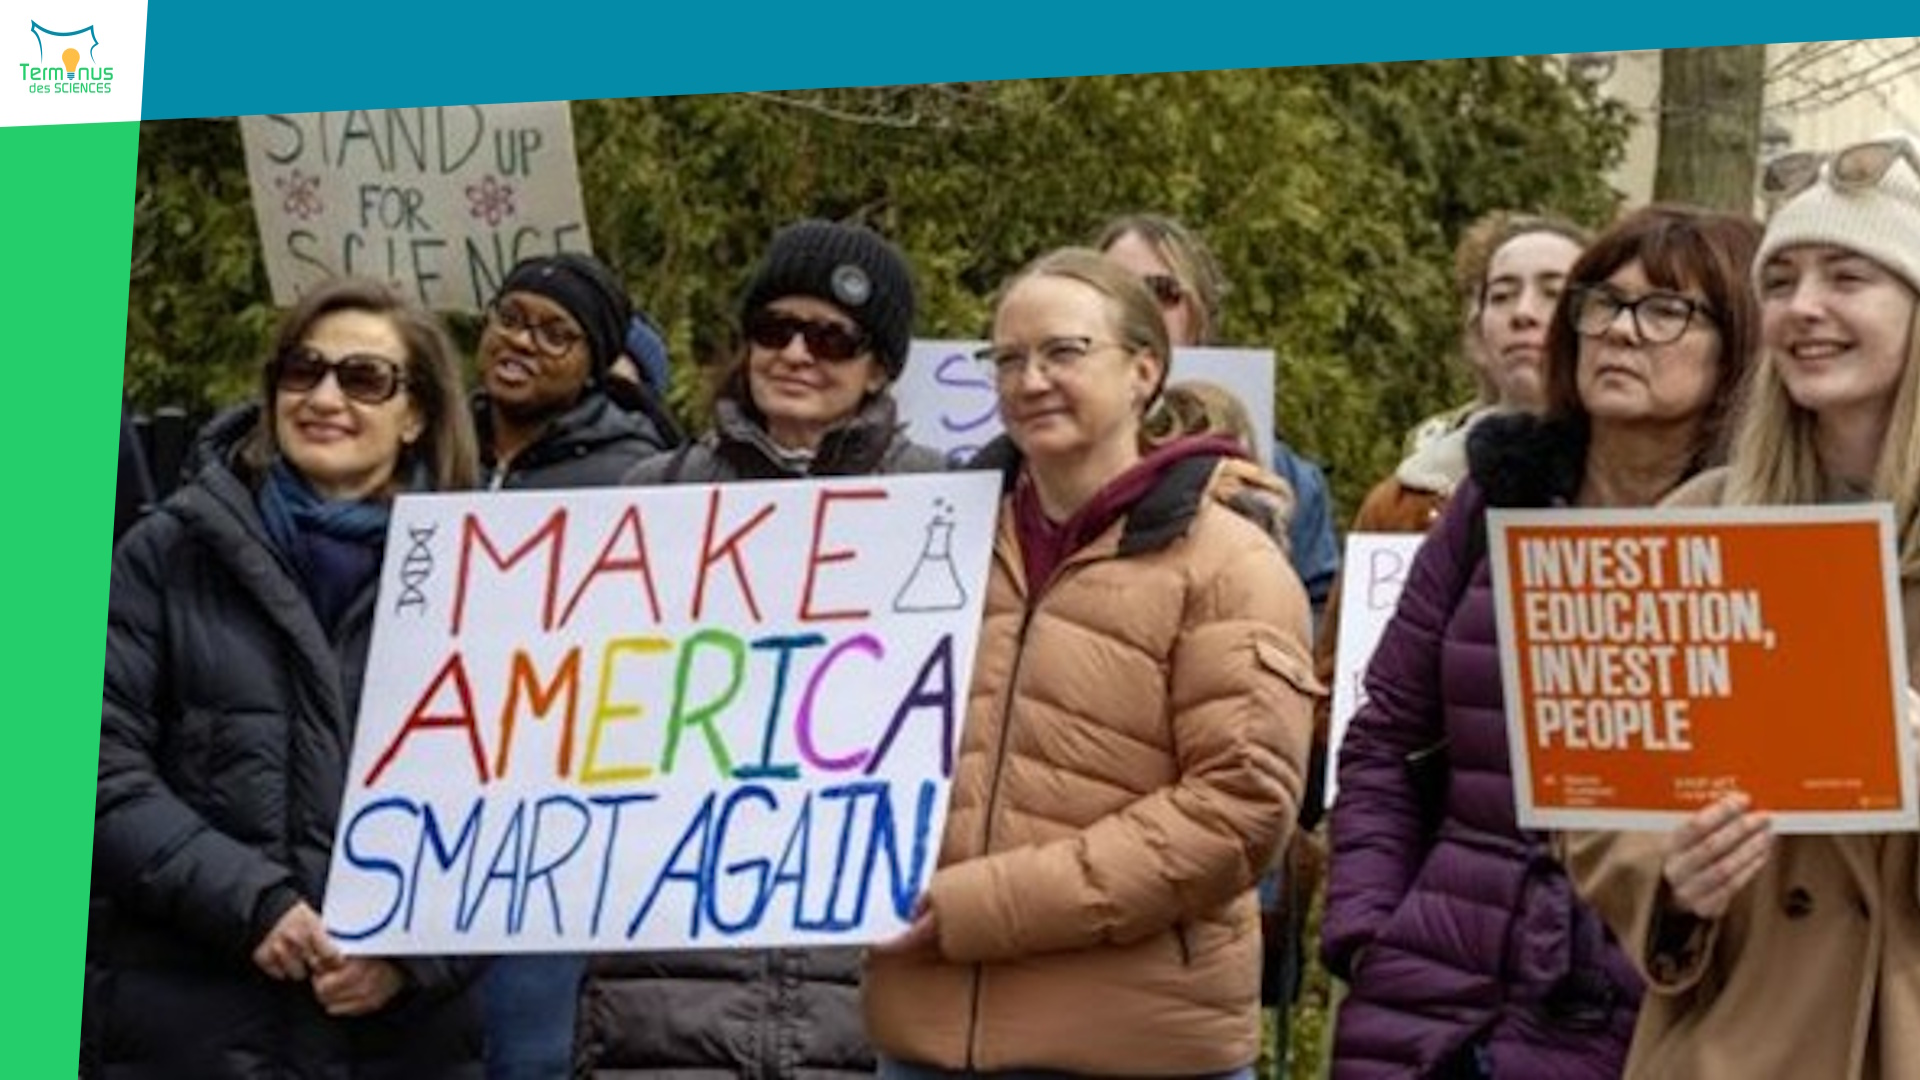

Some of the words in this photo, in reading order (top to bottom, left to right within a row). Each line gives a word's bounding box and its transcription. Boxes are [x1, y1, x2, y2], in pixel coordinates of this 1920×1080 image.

[494, 127, 542, 177] UP
[359, 184, 432, 233] FOR
[450, 488, 889, 635] MAKE
[1518, 536, 1668, 588] INVEST
[1676, 535, 1724, 588] IN
[1523, 588, 1777, 651] EDUCATION,
[1529, 645, 1677, 697] INVEST
[1685, 644, 1732, 697] IN
[364, 629, 958, 786] AMERICA
[1535, 699, 1693, 751] PEOPLE
[327, 792, 659, 940] SMART
[626, 778, 937, 938] AGAIN
